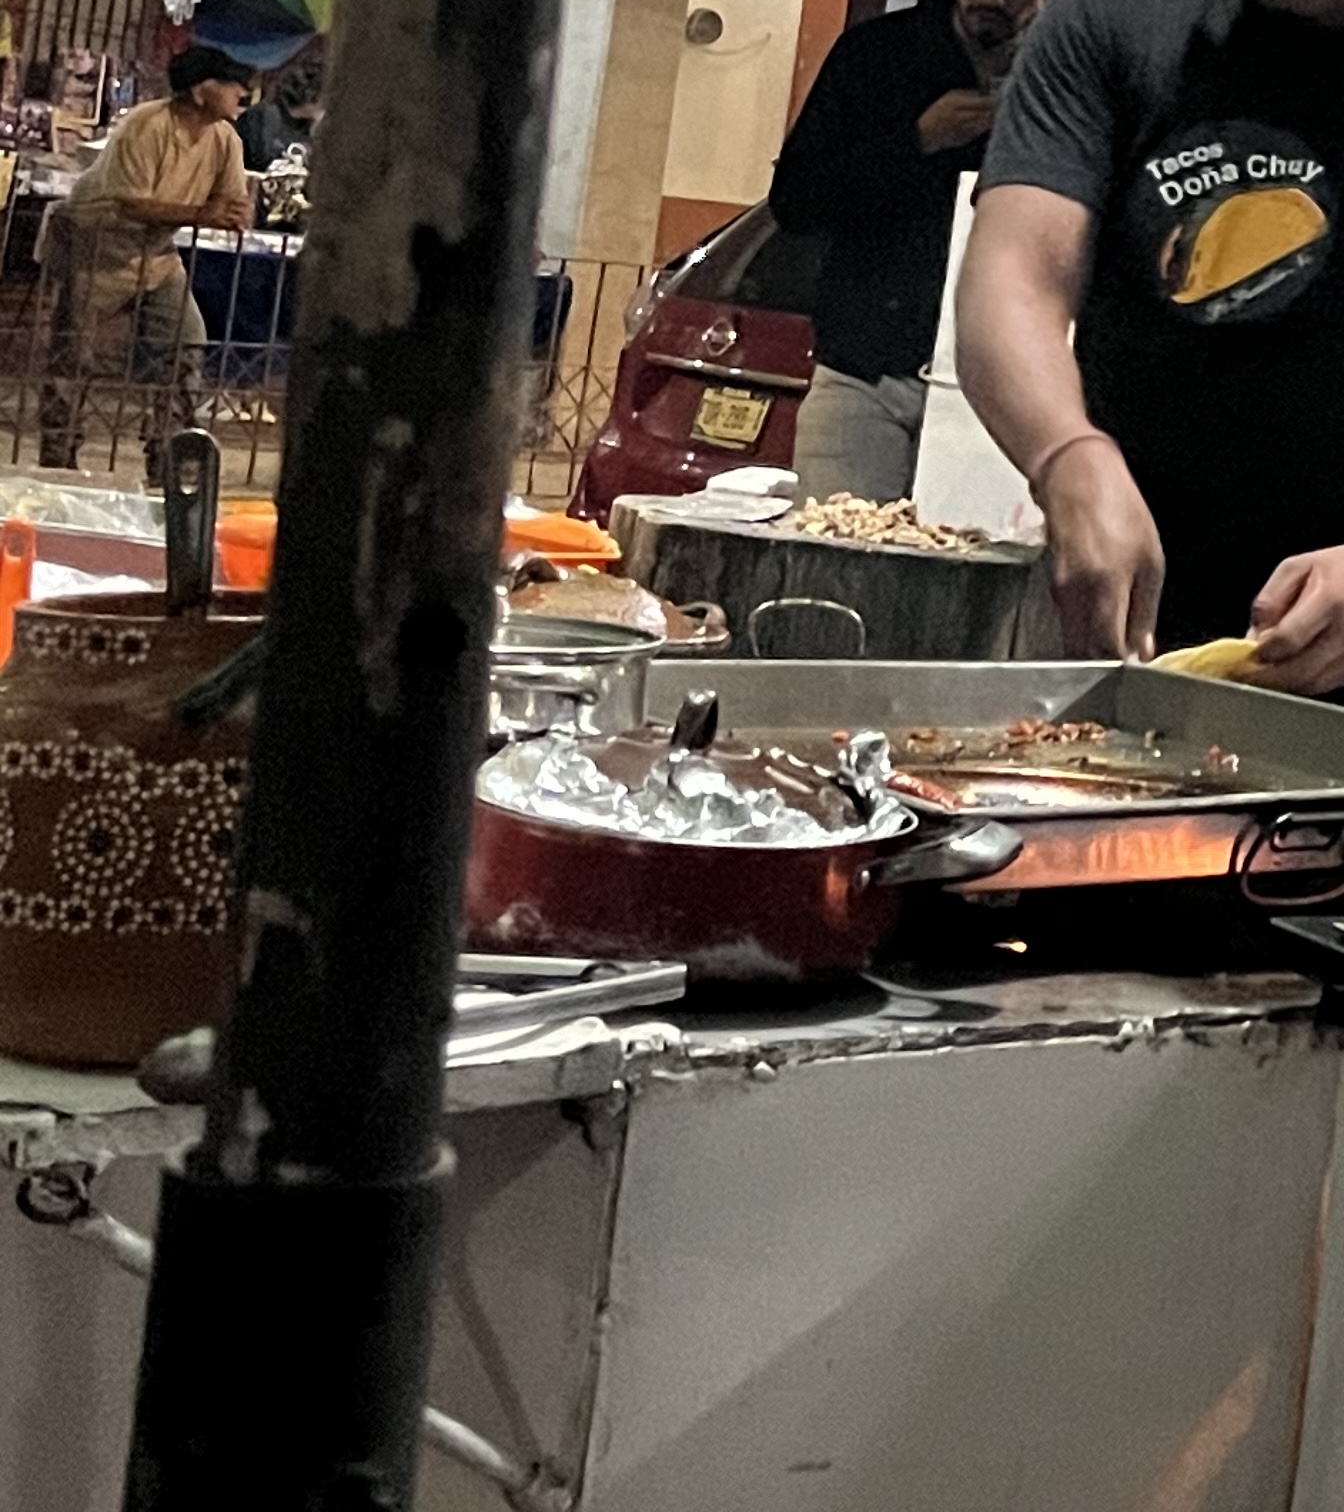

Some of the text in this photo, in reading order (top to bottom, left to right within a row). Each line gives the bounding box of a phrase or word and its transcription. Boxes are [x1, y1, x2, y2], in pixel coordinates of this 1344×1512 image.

[1146, 142, 1225, 182] Tacos
[1159, 153, 1326, 206] Doña Chuy
